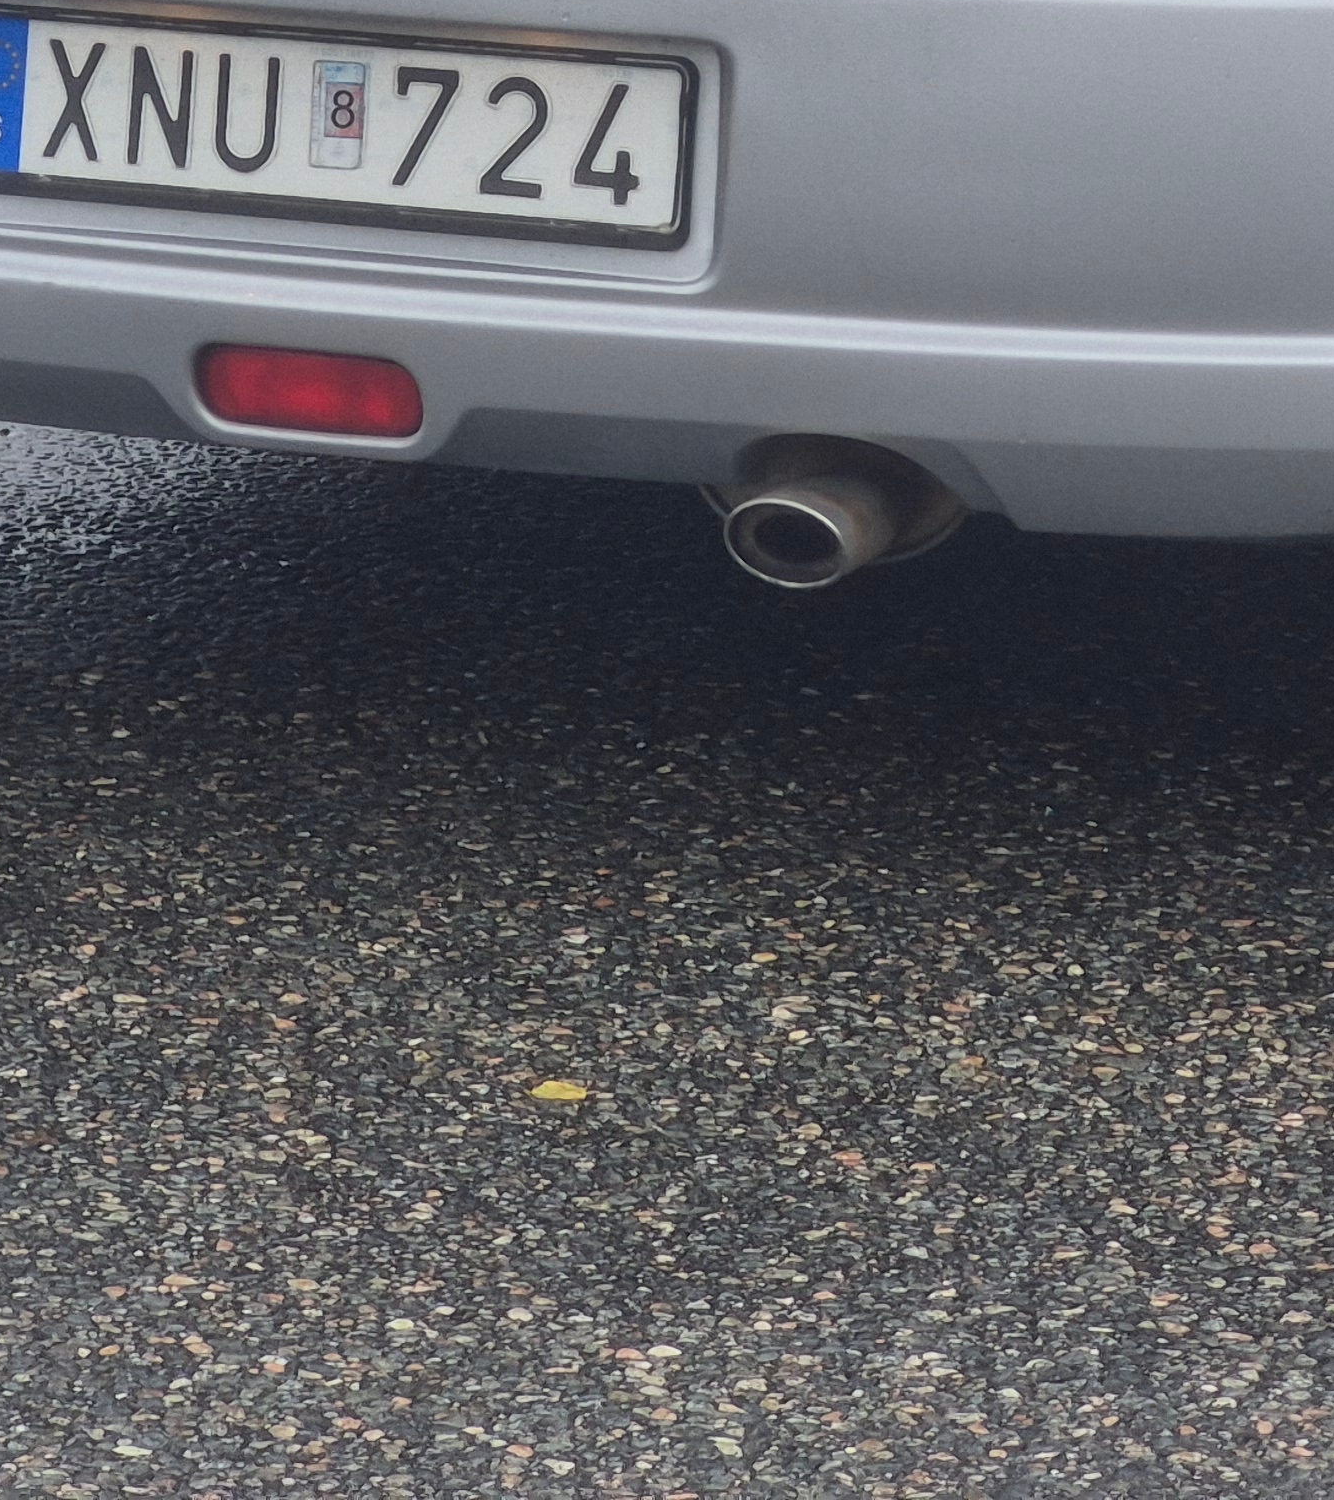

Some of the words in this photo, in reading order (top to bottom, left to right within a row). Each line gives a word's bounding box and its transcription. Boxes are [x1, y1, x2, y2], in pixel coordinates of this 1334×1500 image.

[43, 38, 281, 173] XNU
[392, 66, 640, 205] 724
[330, 89, 355, 129] 8
